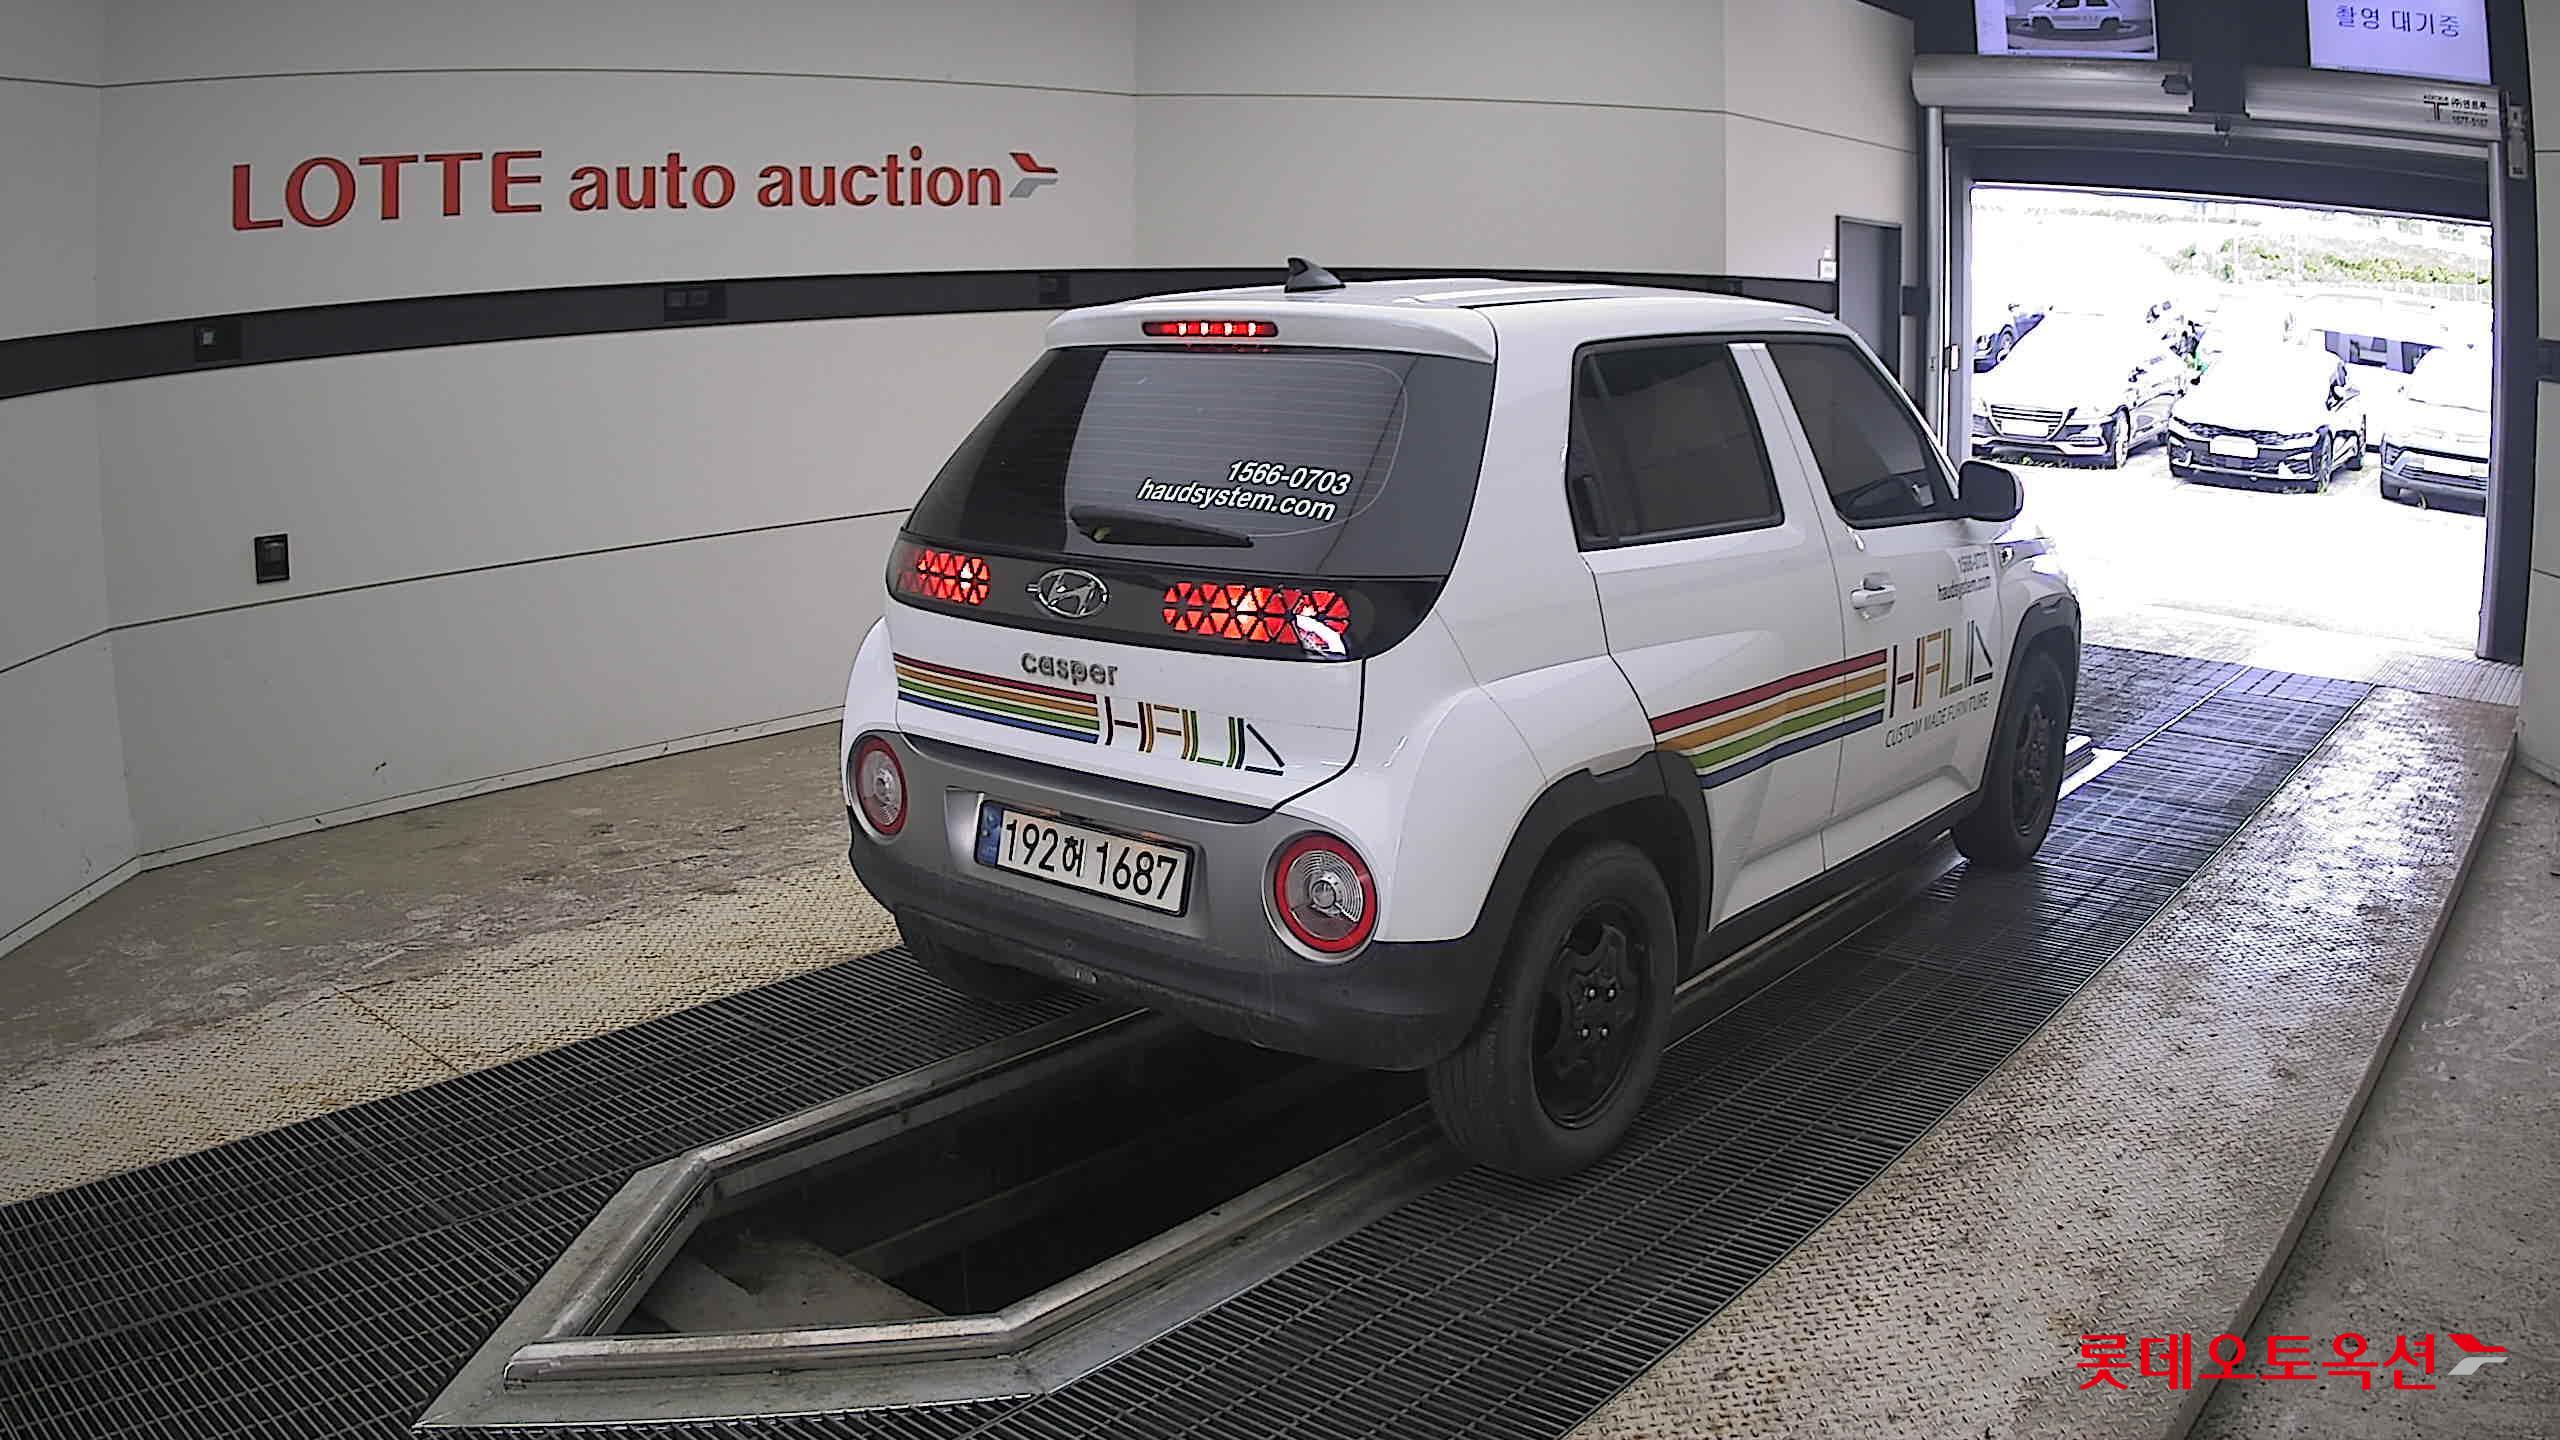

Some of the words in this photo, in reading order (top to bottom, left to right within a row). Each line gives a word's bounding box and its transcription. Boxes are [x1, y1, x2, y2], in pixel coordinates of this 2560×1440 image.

[2336, 5, 2379, 30] 촬영
[232, 149, 543, 232] LOTTE
[568, 152, 736, 210] auto
[756, 146, 1002, 208] auction
[1226, 460, 1352, 496] 1566-0703
[1136, 477, 1338, 522] haudsystem.com
[1020, 652, 1119, 686] casper
[1005, 818, 1087, 878] 192허
[1096, 840, 1179, 901] 1687
